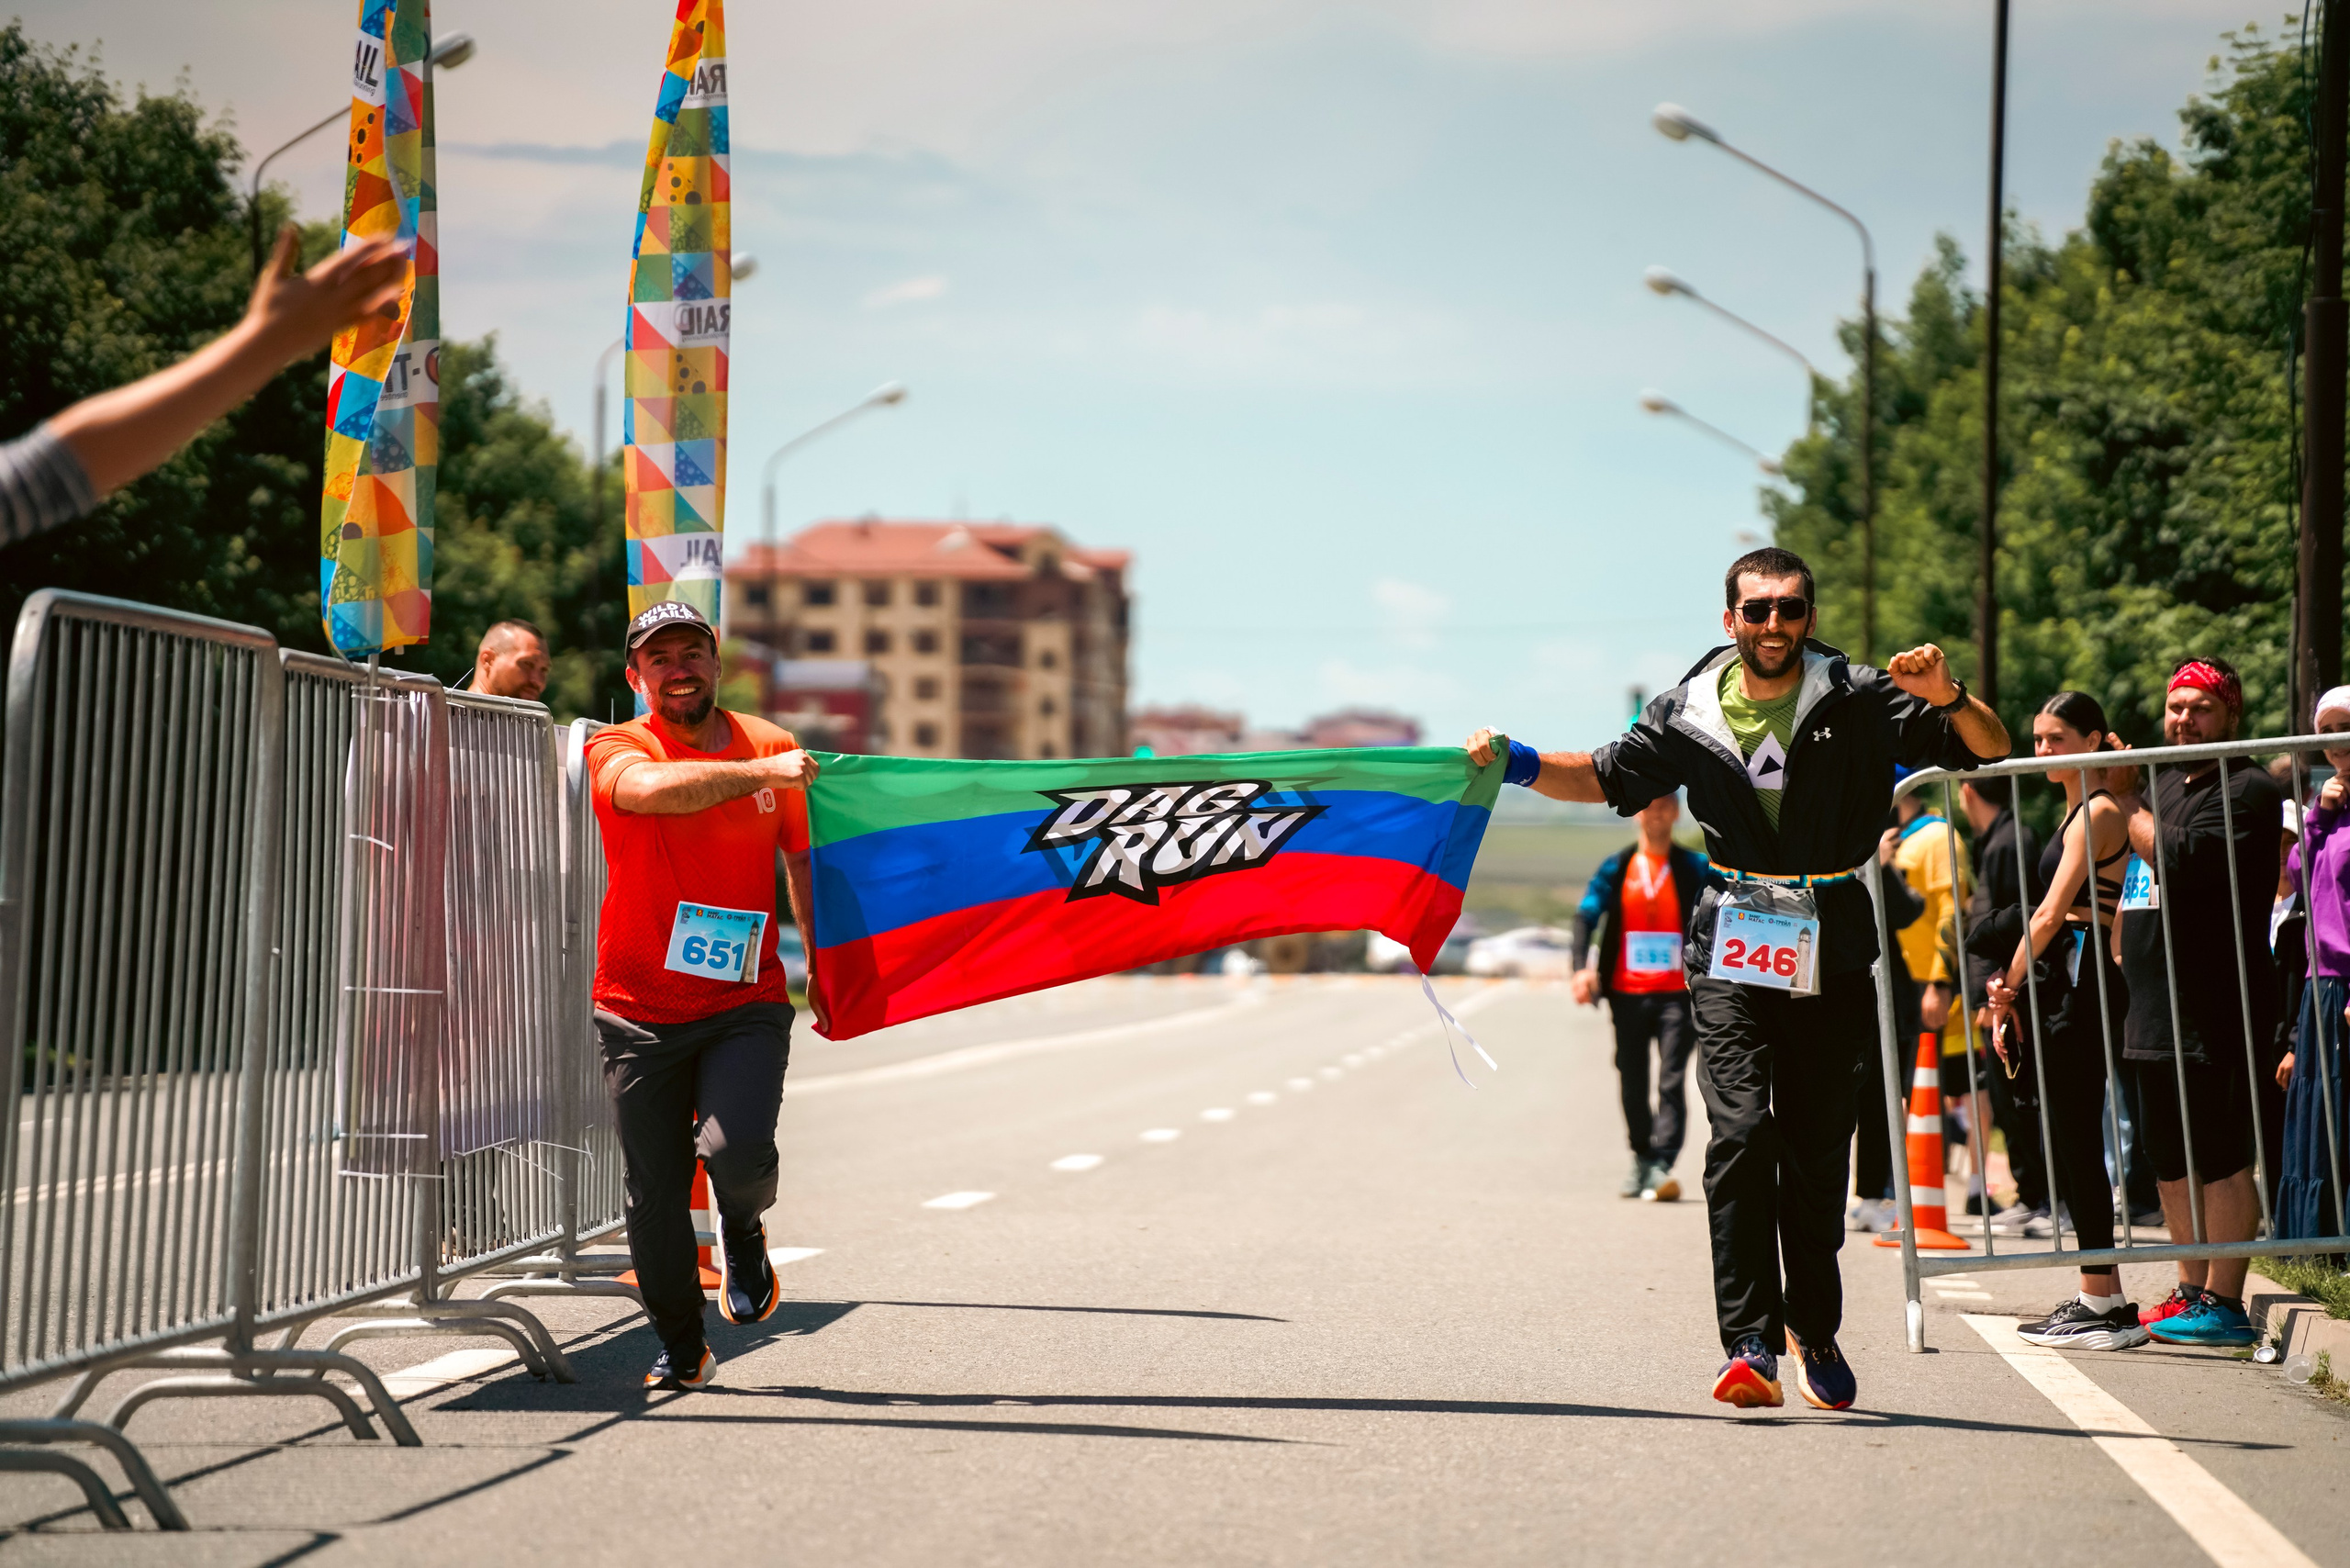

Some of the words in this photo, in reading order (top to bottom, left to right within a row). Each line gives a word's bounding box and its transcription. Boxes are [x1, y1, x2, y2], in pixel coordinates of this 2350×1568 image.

[638, 602, 679, 622] WILD
[638, 610, 685, 629] TRAIL
[752, 787, 777, 814] 10
[1040, 781, 1261, 841] DAG
[1083, 811, 1307, 892] RUN
[682, 935, 745, 971] 651
[1722, 938, 1798, 977] 246
